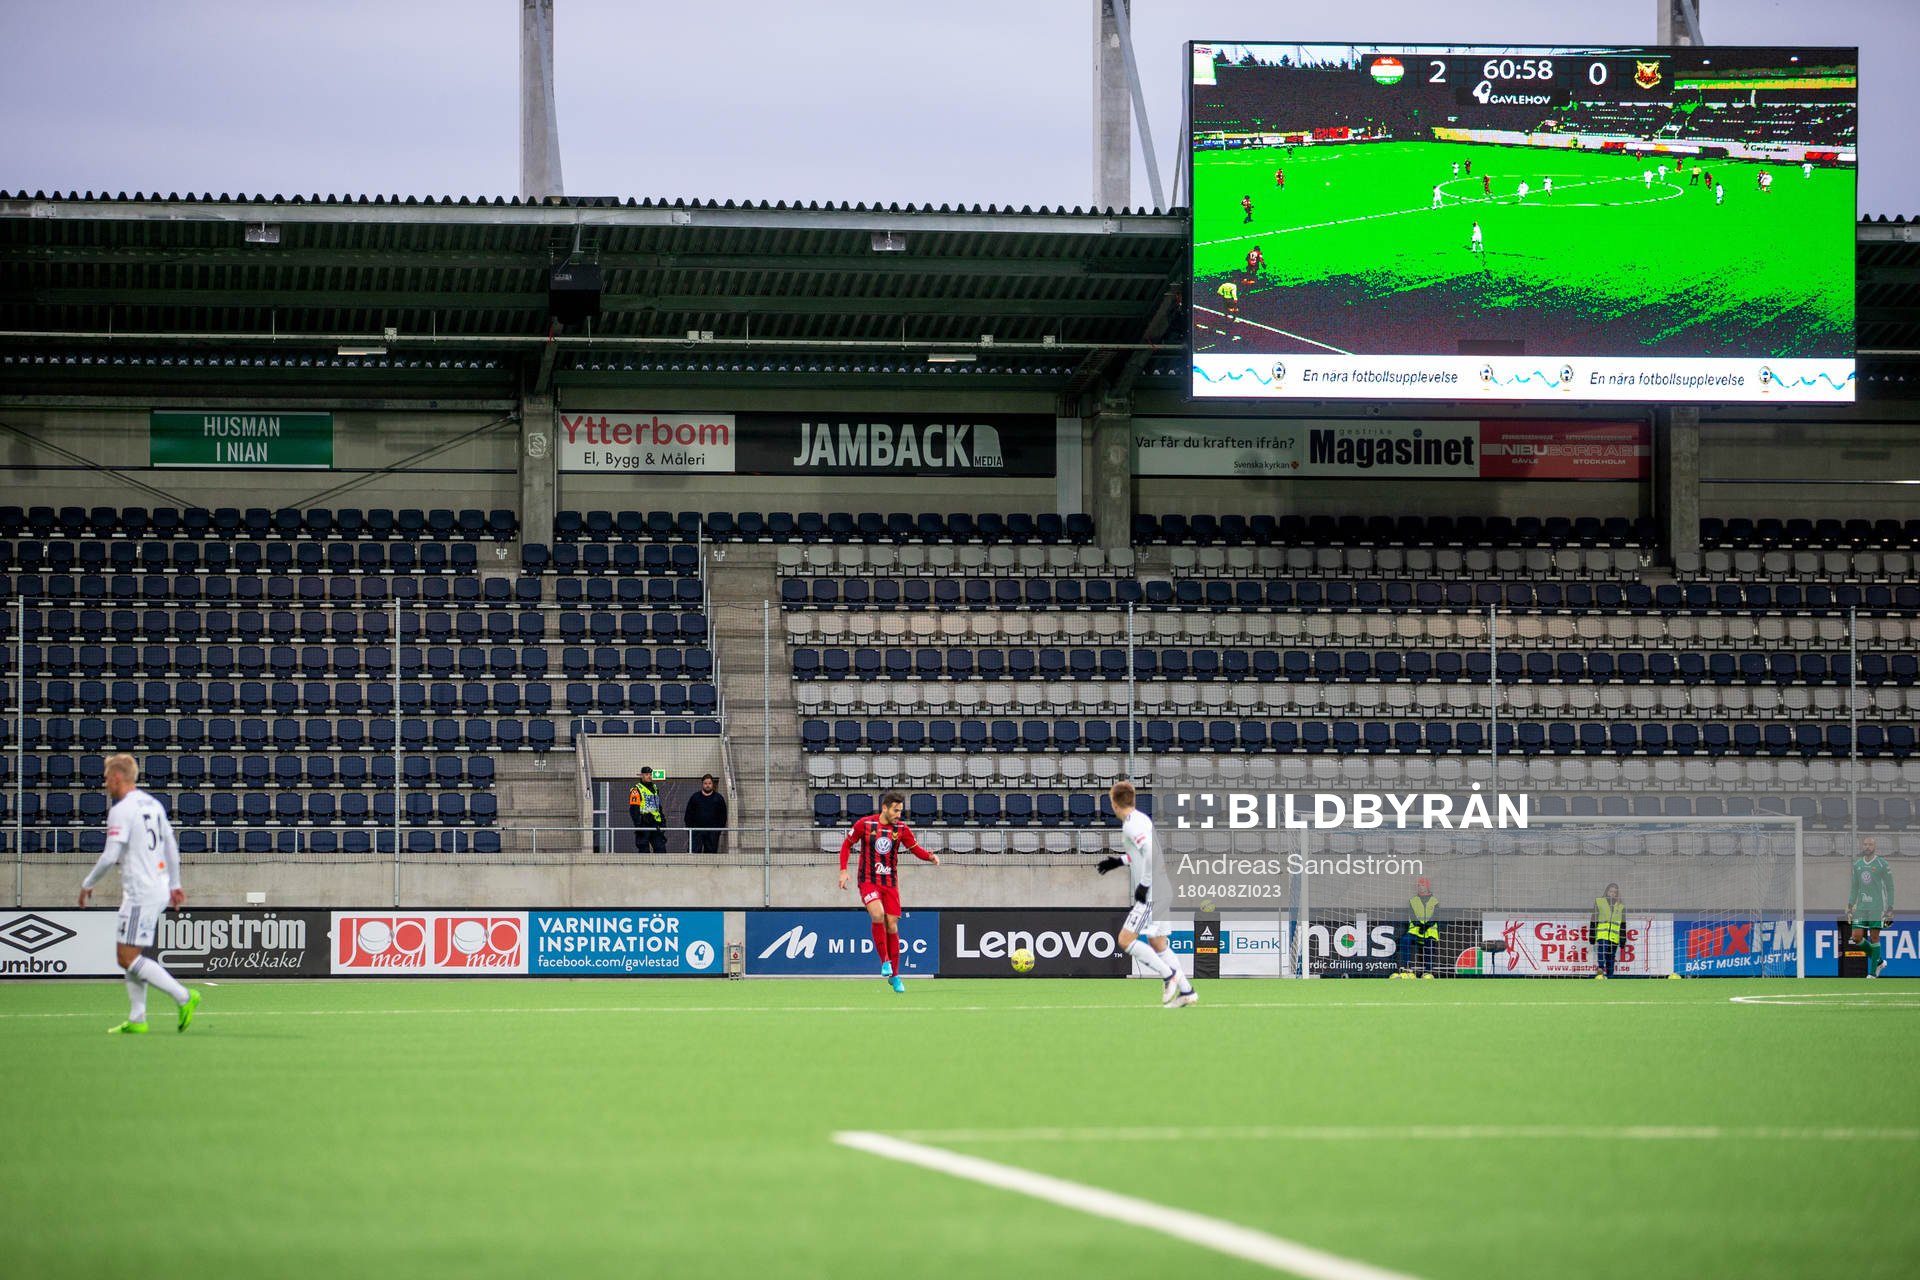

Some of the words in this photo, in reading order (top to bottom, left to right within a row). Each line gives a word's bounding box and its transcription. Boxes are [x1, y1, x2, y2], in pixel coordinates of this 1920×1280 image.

[1429, 60, 1446, 83] 2
[1483, 59, 1553, 79] 60:58
[1589, 62, 1607, 85] 0
[1303, 369, 1319, 382] En
[1322, 369, 1348, 383] nära
[1351, 369, 1458, 386] fotbollsupplevelse
[1590, 371, 1605, 385] En
[1609, 372, 1635, 385] nära
[1638, 372, 1745, 388] fotbollsupplevelse
[204, 416, 280, 437] HUSMAN
[561, 415, 729, 446] Ytterbom
[793, 423, 971, 467] JAMBACK
[974, 455, 1003, 467] MEDIA
[1135, 436, 1156, 449] Var
[1161, 435, 1180, 449] får
[1183, 436, 1200, 449] du
[1203, 436, 1252, 449] kraften
[1256, 436, 1295, 449] ifrån?
[1310, 429, 1474, 469] Magasinet
[227, 442, 268, 462] NIAN
[584, 452, 599, 466] El,
[605, 452, 640, 468] Bygg
[645, 452, 655, 465] &
[661, 451, 705, 466] Måleri
[1234, 460, 1263, 469] Svenska
[1264, 460, 1290, 471] kyrkan
[538, 917, 636, 934] VARNING
[639, 913, 679, 934] FÖR
[158, 913, 306, 956] högström
[538, 935, 679, 953] INSPIRATION
[956, 924, 1115, 959] Lenovo
[1236, 936, 1280, 950] Bank
[828, 938, 928, 954] MIDOC
[1612, 944, 1636, 963] B
[538, 954, 680, 971] facebook.com/gavlestad
[1329, 960, 1363, 972] drilling
[1365, 961, 1398, 972] system
[1685, 959, 1715, 972] BÄST
[1716, 956, 1752, 969] MUSIK
